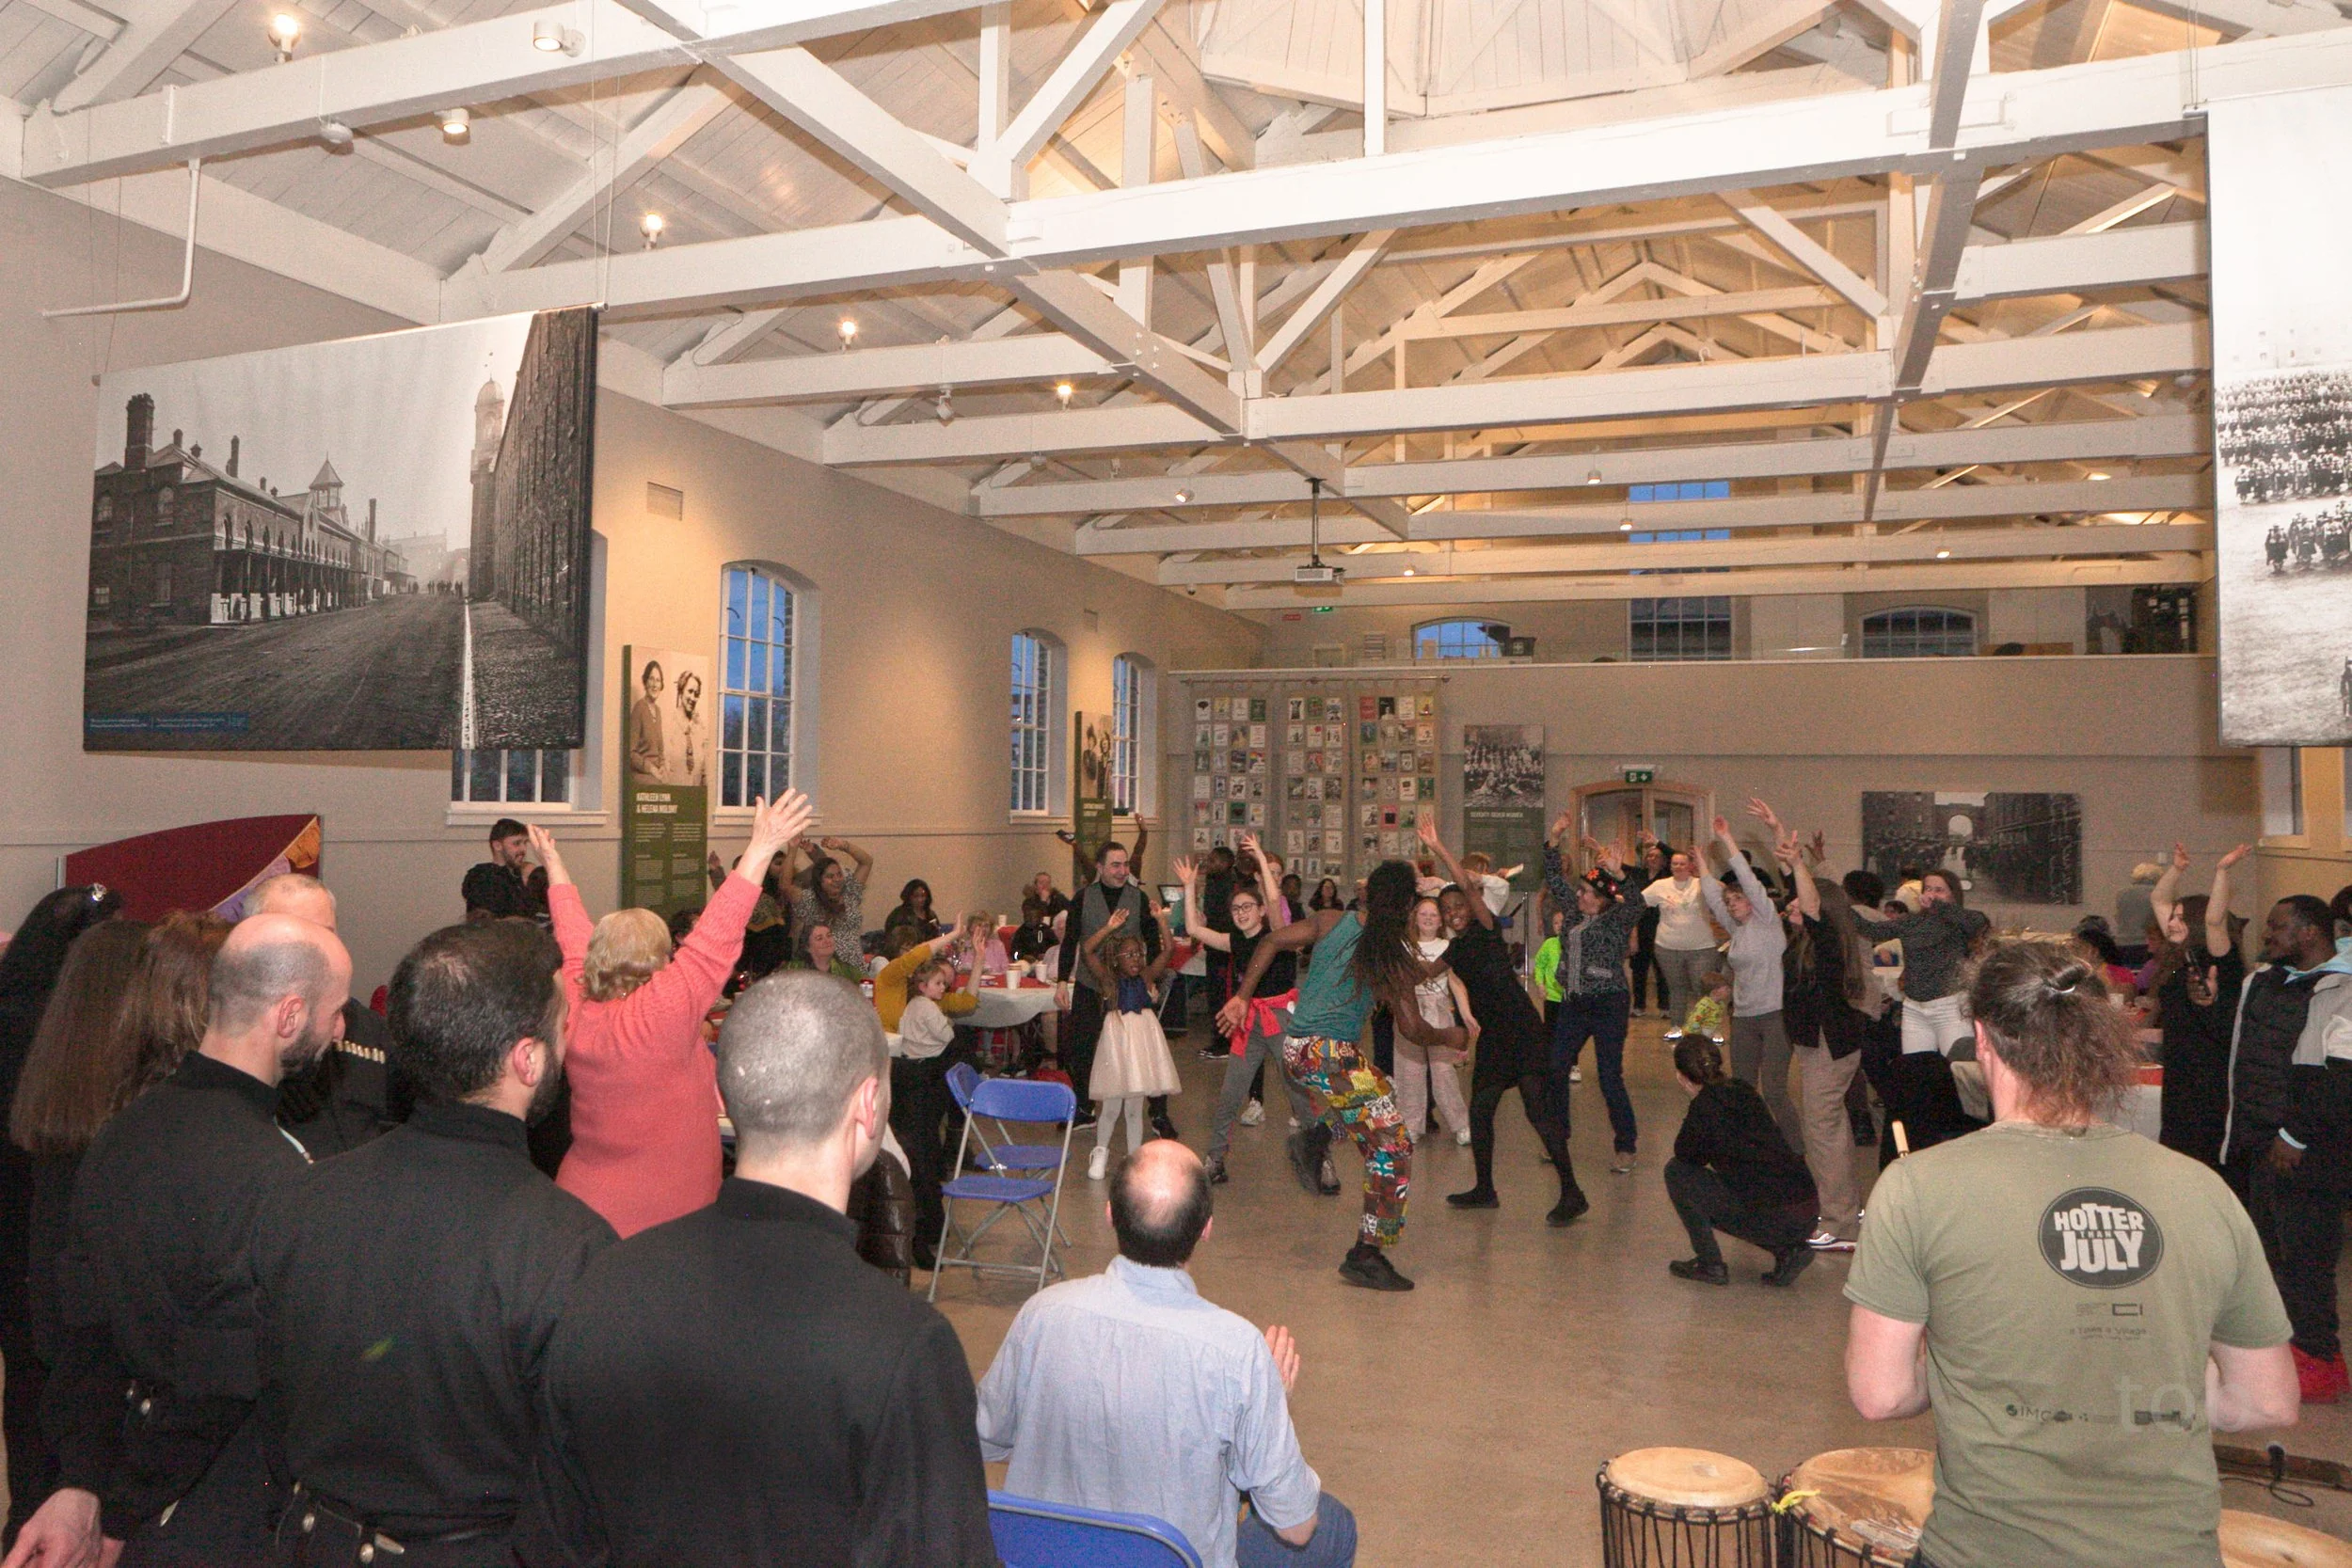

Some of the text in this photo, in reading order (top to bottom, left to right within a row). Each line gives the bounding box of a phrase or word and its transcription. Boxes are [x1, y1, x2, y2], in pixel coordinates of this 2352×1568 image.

[2054, 1203, 2145, 1231] HOTTER
[2080, 1230, 2113, 1239] THAN
[2060, 1230, 2143, 1273] JULY
